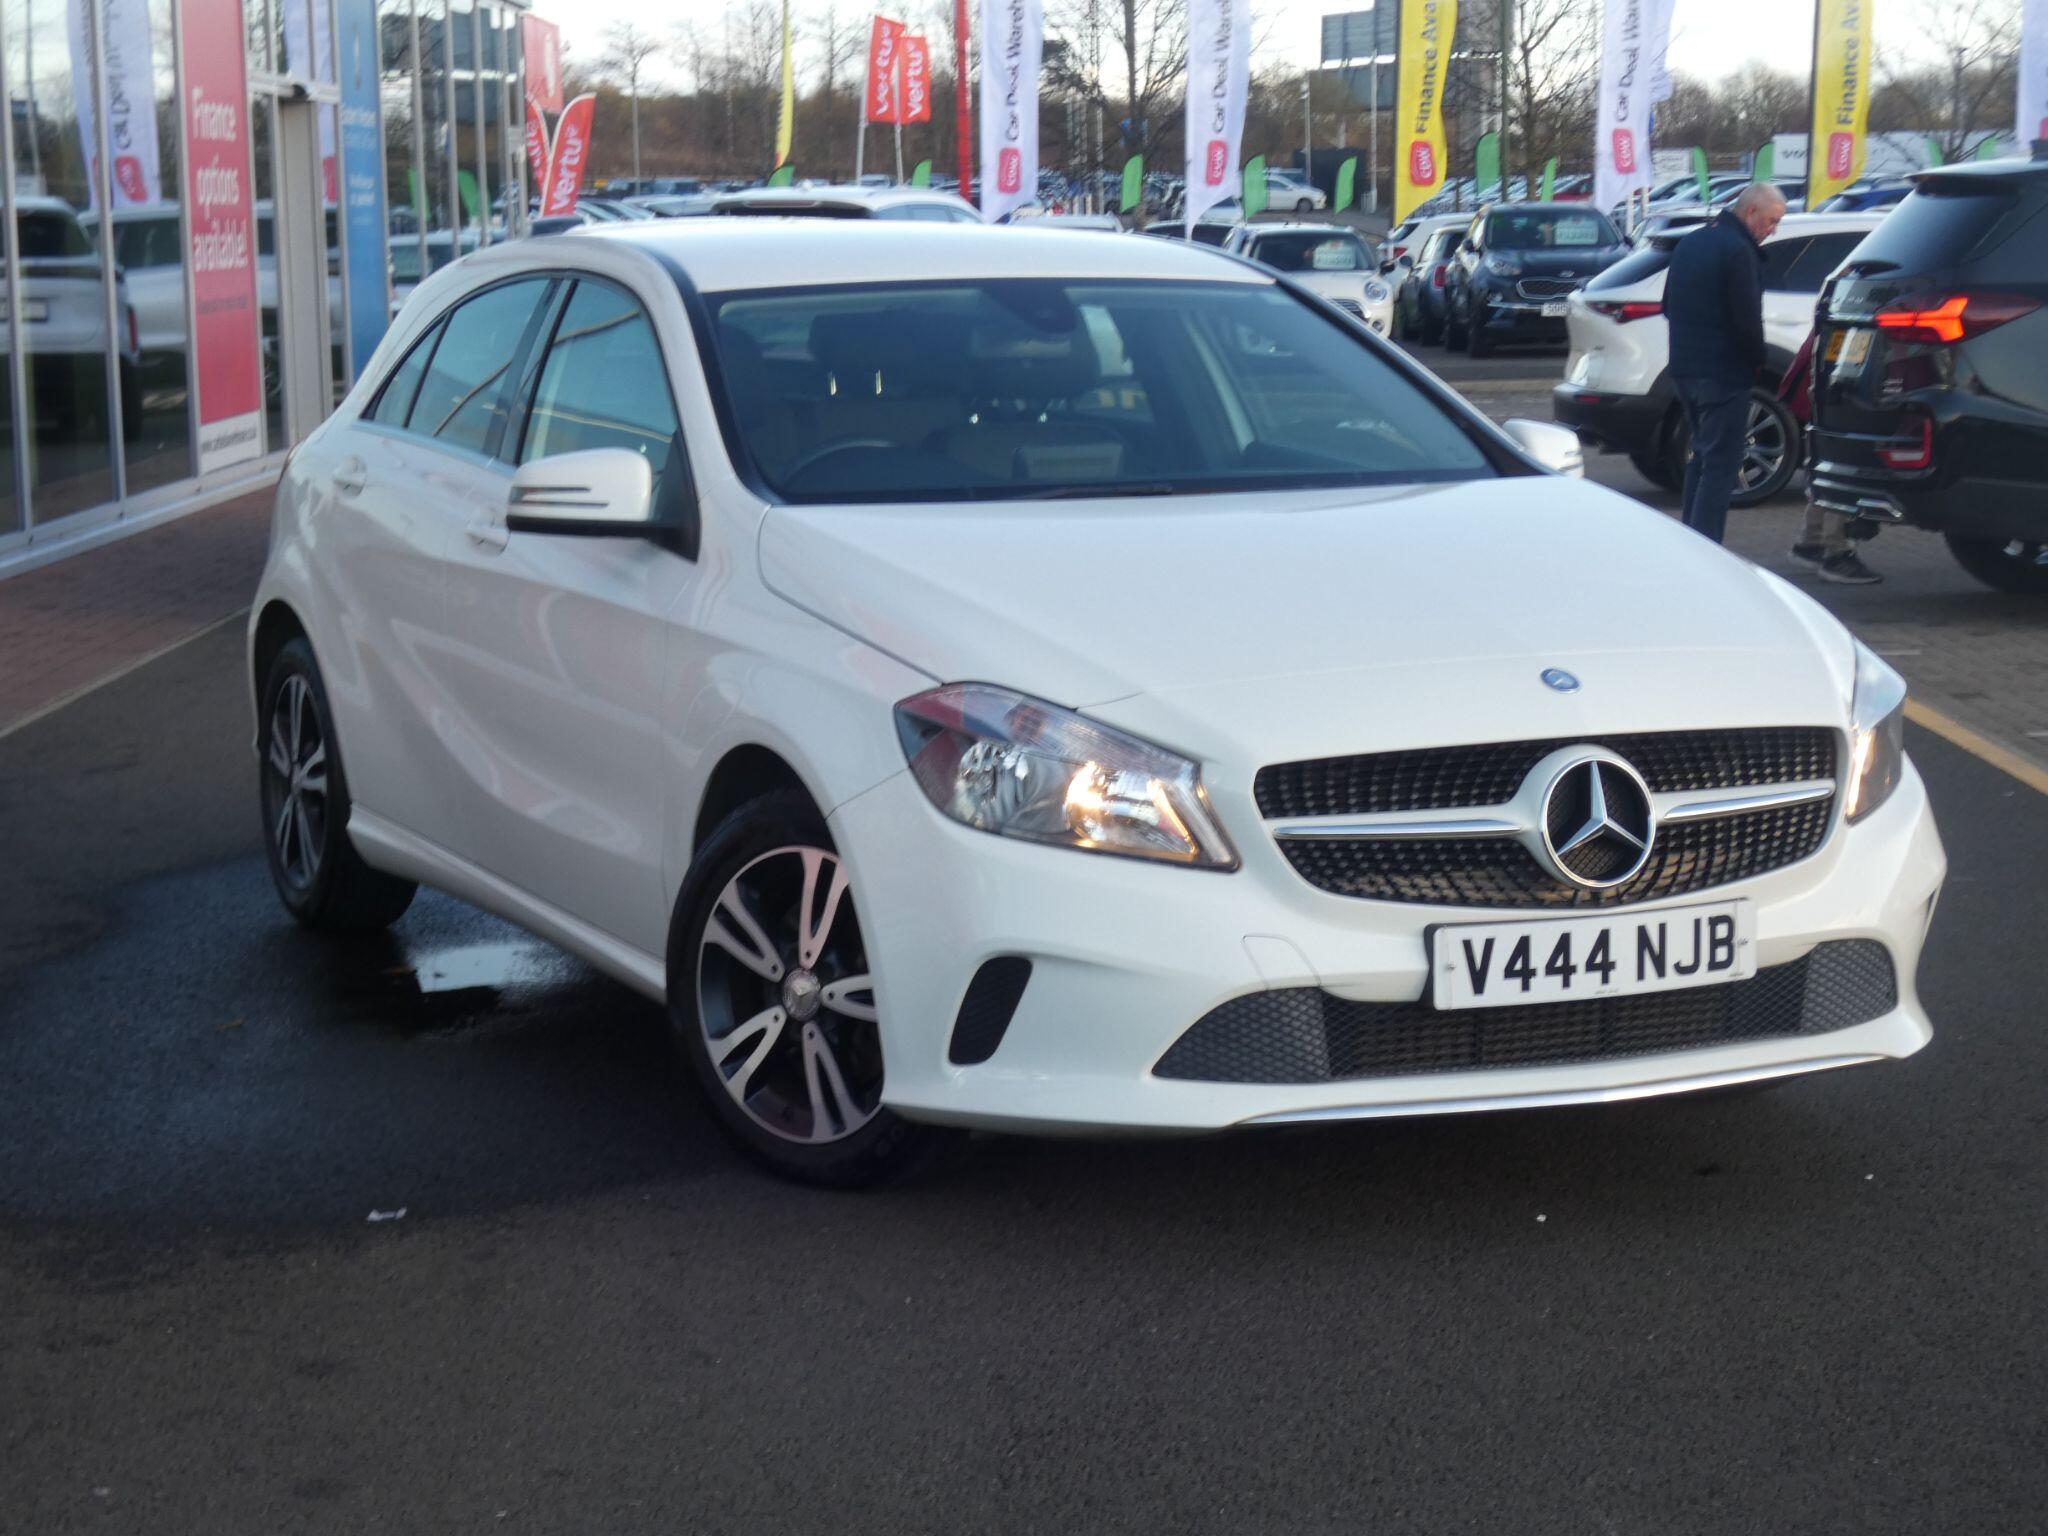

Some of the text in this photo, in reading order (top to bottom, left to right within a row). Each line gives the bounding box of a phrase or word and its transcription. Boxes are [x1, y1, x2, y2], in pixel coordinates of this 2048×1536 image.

[876, 37, 893, 116] vertu
[907, 49, 924, 118] vertu
[1005, 63, 1020, 106] Deal
[1213, 0, 1232, 134] Car Deal Ware
[1416, 48, 1437, 134] Finance
[1618, 47, 1640, 88] Deal
[1837, 37, 1860, 125] Finance
[191, 86, 237, 141] Finance
[1005, 111, 1019, 141] Car
[1616, 92, 1628, 122] Car
[196, 153, 240, 220] options
[551, 137, 583, 211] vertu
[1462, 914, 1736, 996] V444 NJB
